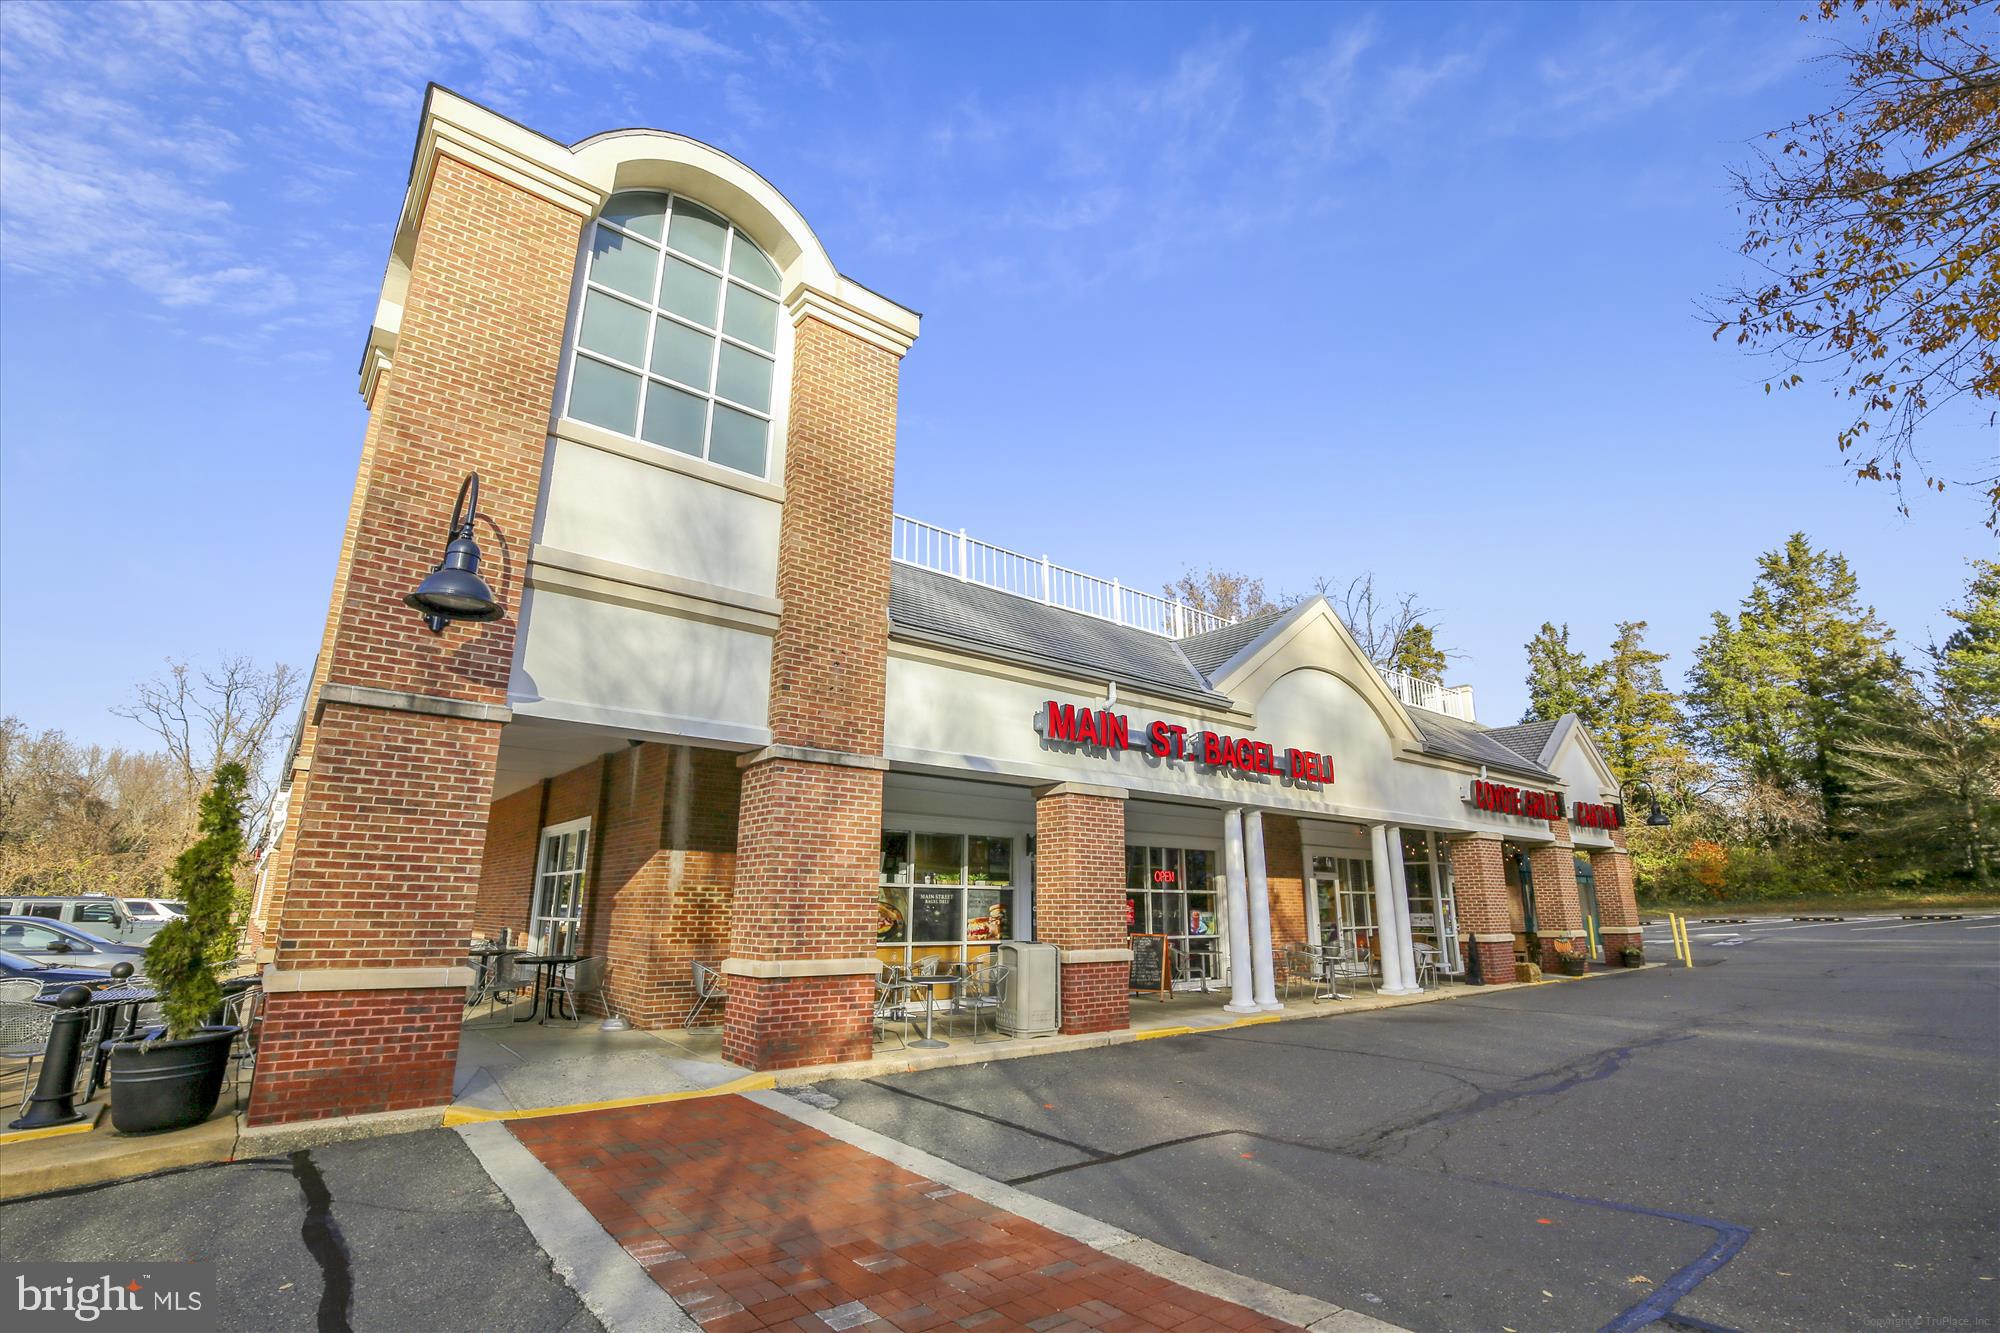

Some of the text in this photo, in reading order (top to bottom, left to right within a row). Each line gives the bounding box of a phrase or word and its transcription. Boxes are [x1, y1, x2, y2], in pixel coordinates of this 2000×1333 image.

[1046, 700, 1335, 785] MAIN ST. BAGEL DELI
[1475, 779, 1521, 816] COYOTE
[1154, 871, 1175, 882] OPEN
